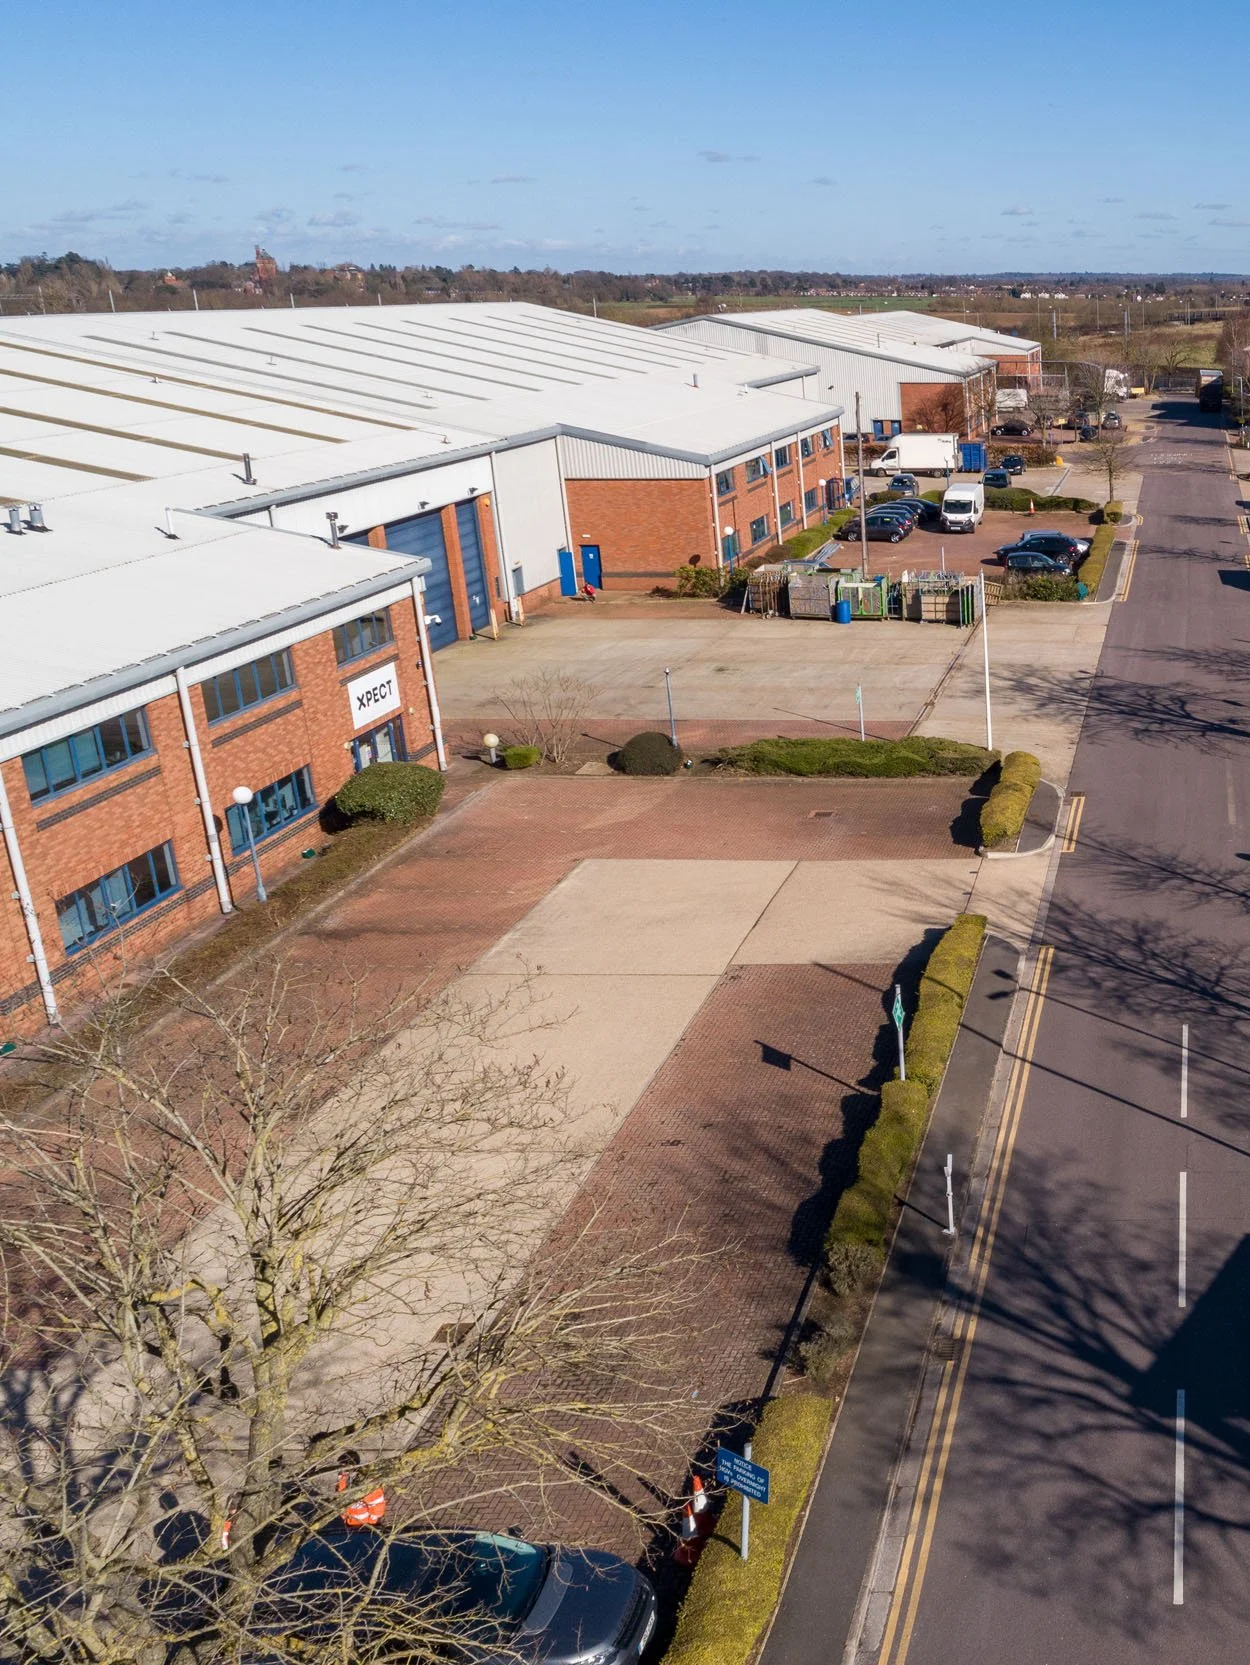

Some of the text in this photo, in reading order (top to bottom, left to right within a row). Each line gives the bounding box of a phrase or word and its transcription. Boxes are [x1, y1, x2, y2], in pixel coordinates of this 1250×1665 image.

[356, 679, 392, 711] XPECT
[721, 1458, 765, 1484] THE PARKING OF
[733, 1457, 753, 1471] NOTICE
[730, 1478, 762, 1498] PROHIBITED
[736, 1474, 767, 1493] OVERNIGHT
